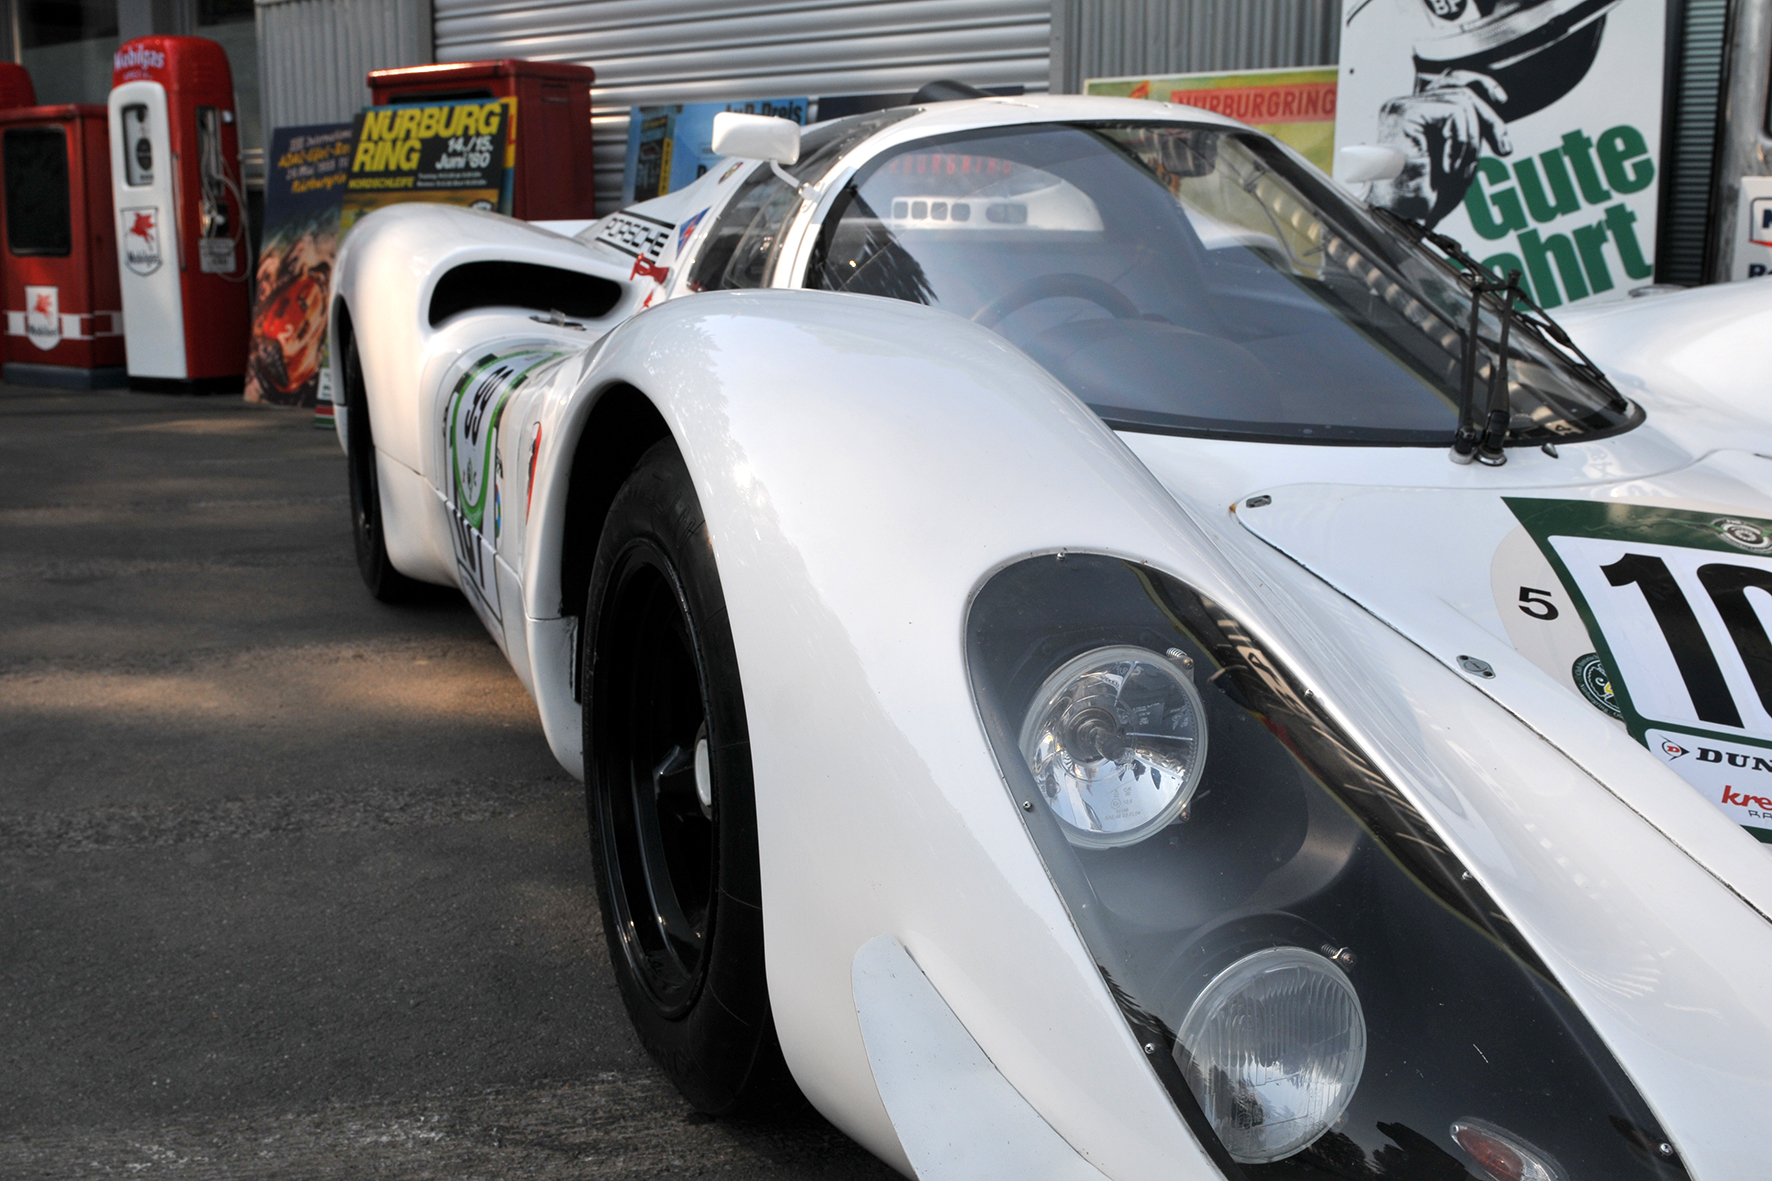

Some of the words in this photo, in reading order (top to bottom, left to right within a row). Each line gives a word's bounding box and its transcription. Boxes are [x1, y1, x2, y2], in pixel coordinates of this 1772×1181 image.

[360, 104, 503, 141] NÜRBURG
[352, 139, 423, 173] RING
[435, 151, 466, 171] Juni
[347, 176, 415, 190] NORDSCHLEIFE
[1464, 124, 1656, 241] Gute
[603, 216, 671, 259] PORSCHE
[1446, 203, 1654, 312] ahrt
[1518, 586, 1560, 622] 5
[1696, 747, 1772, 773] DUN
[1721, 785, 1772, 811] kre
